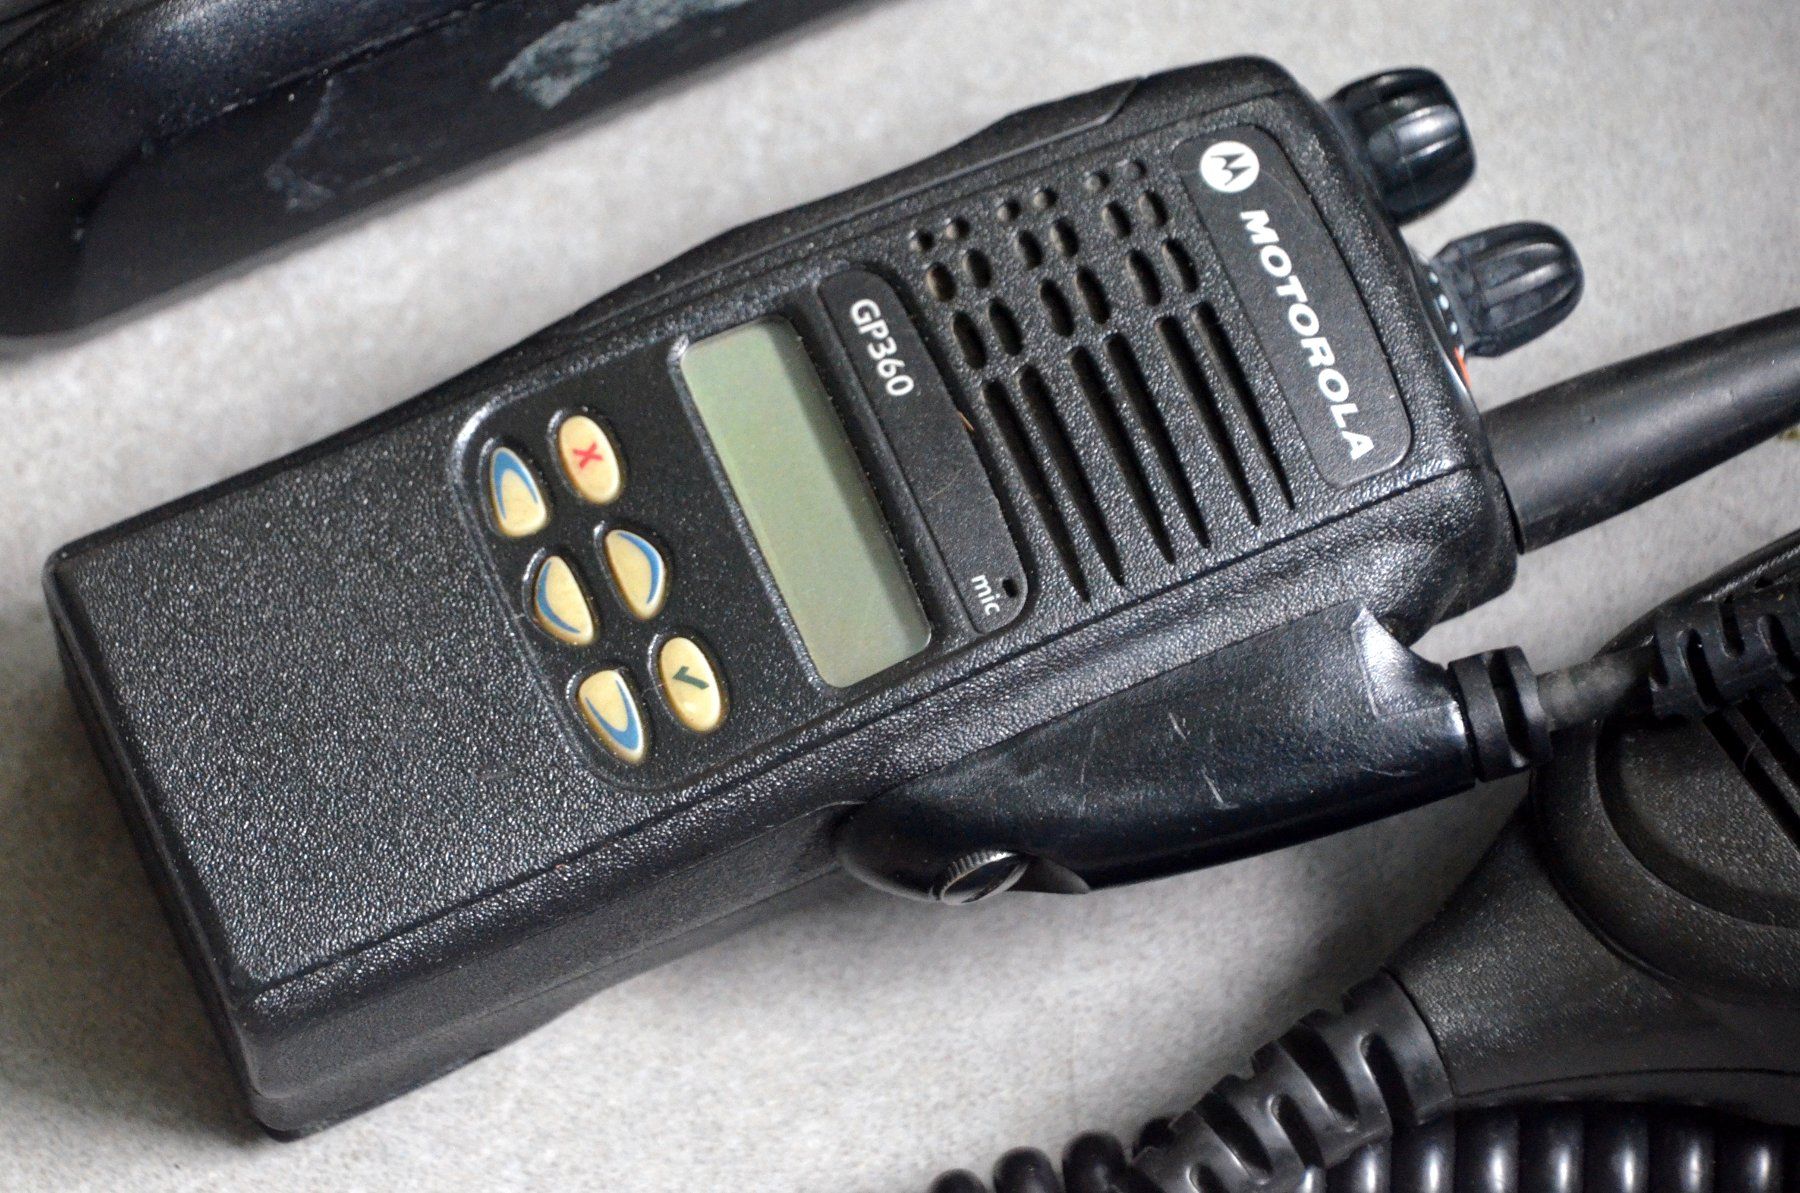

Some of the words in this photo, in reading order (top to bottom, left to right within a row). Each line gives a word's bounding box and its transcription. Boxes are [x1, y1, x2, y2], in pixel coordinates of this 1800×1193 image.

[850, 298, 914, 396] GP360
[1240, 209, 1375, 460] MOTOROLA
[971, 574, 1001, 616] mic
